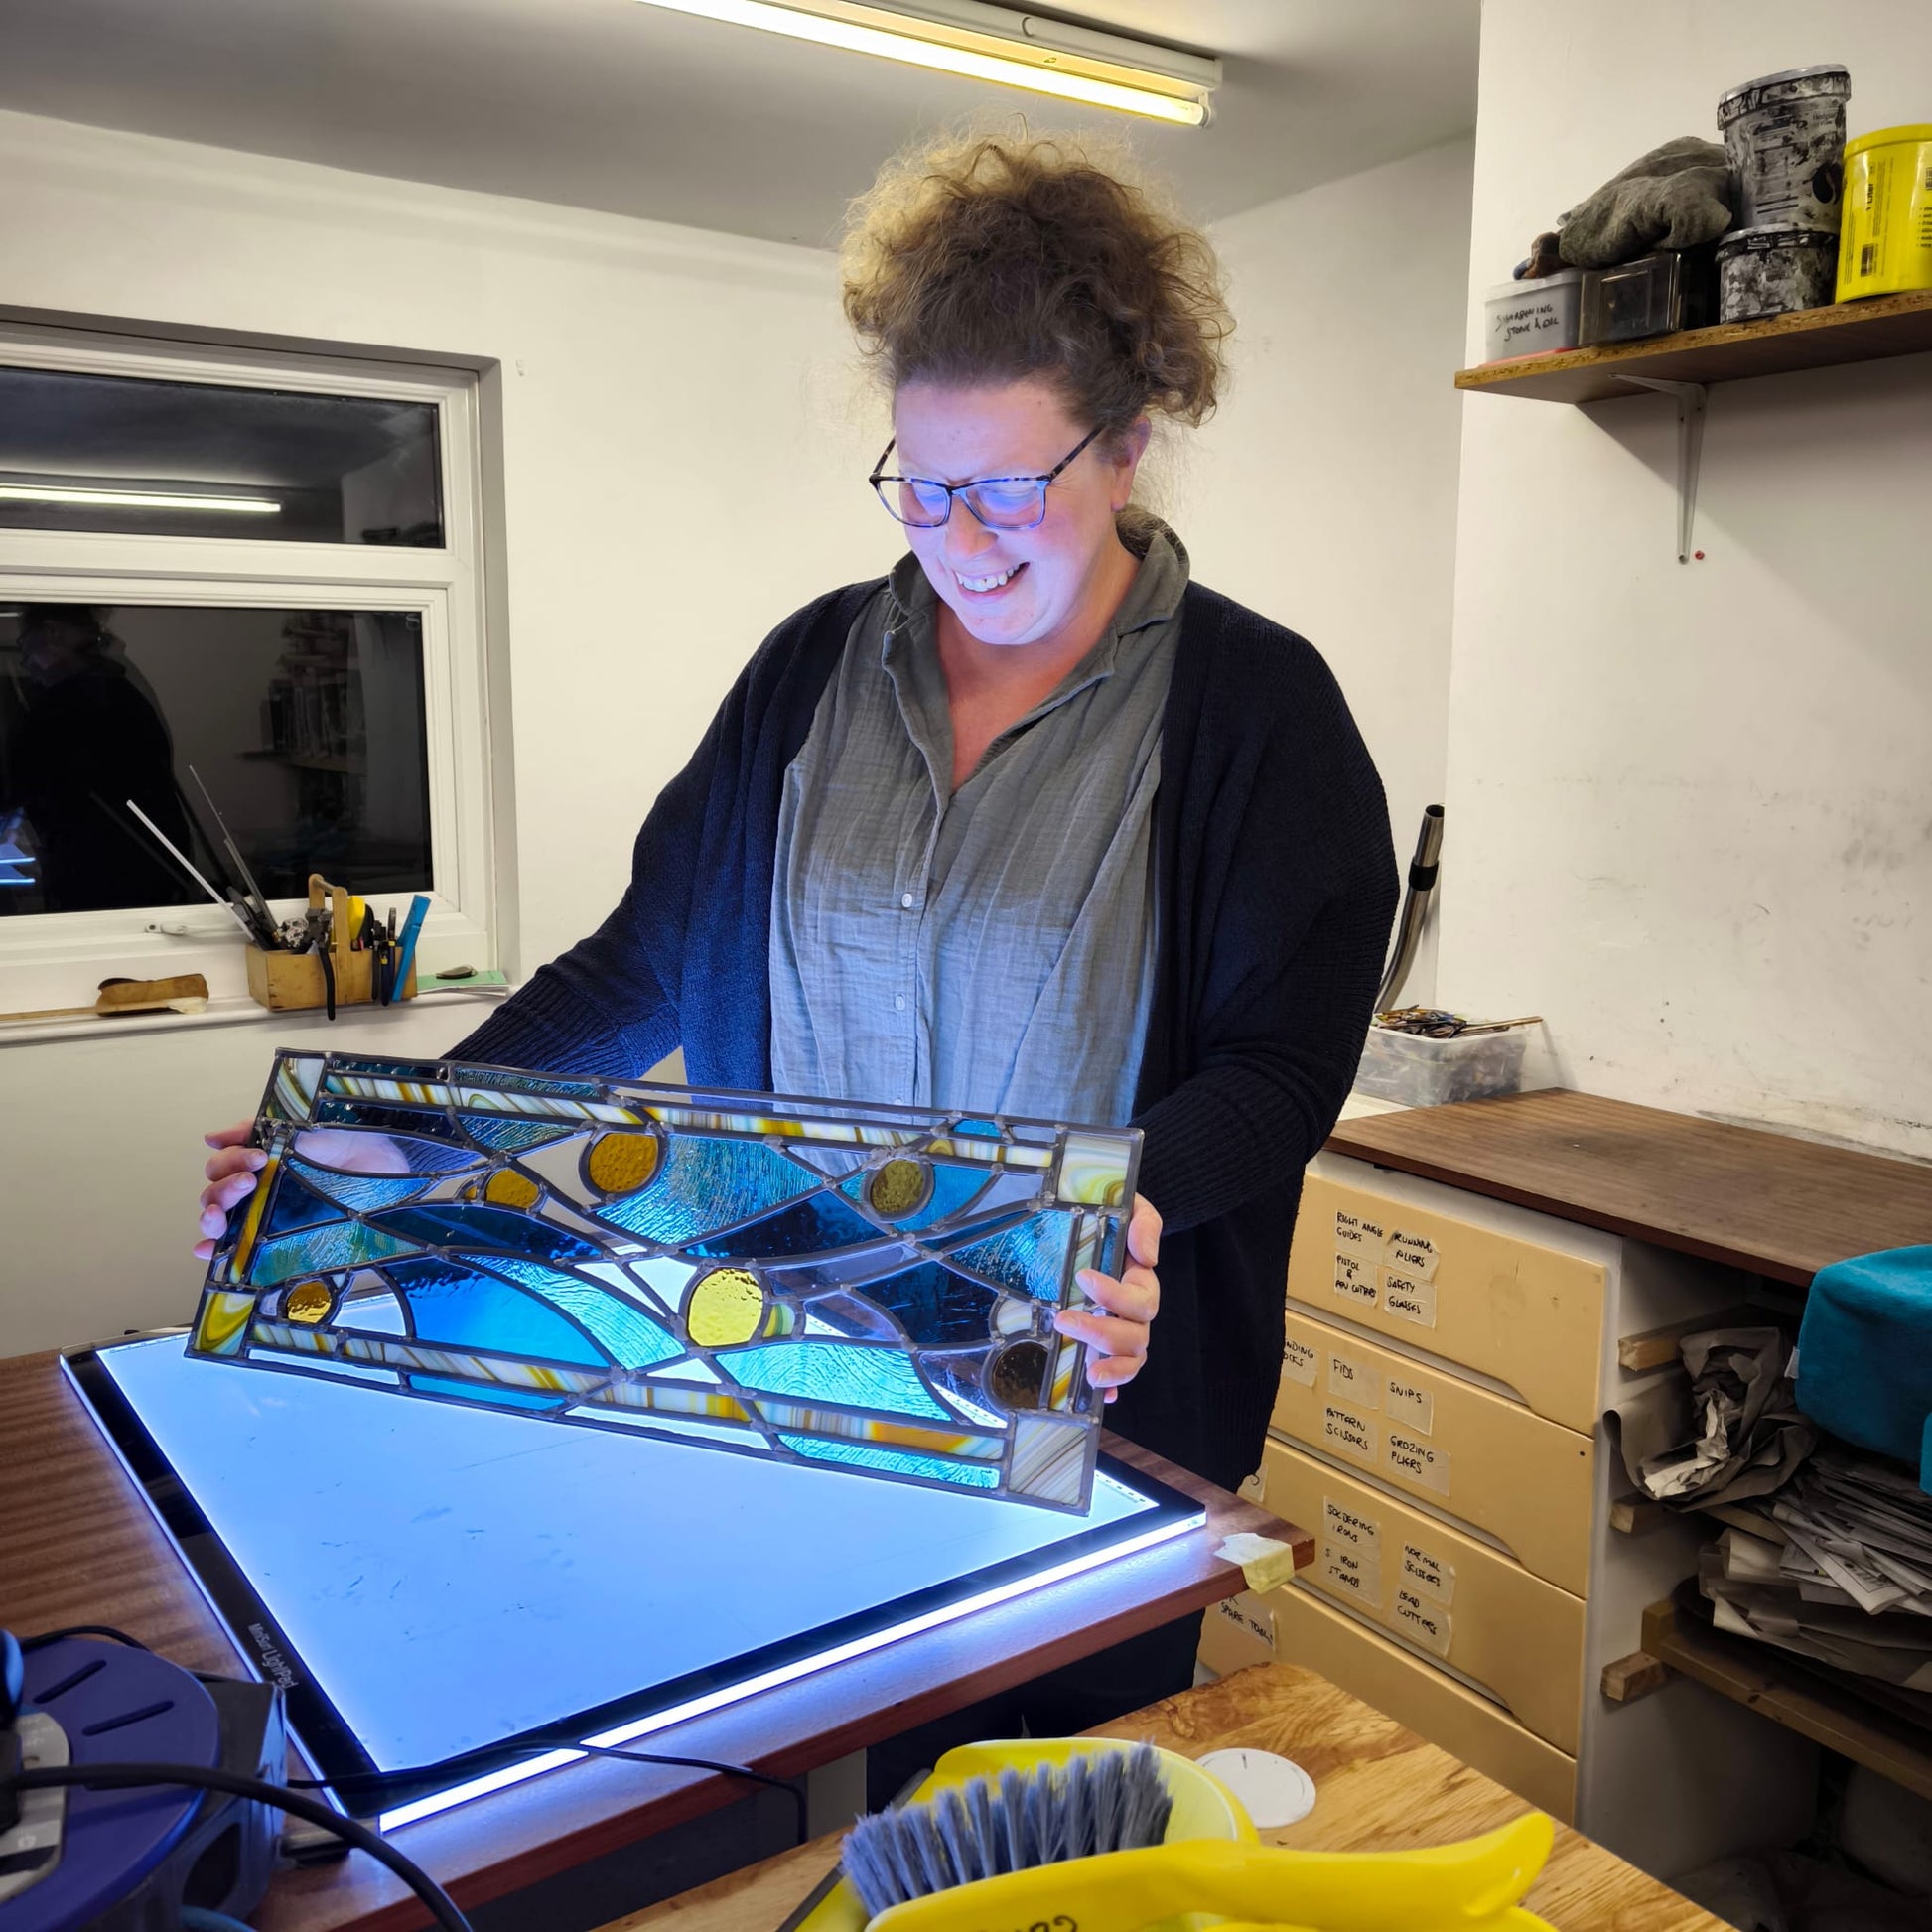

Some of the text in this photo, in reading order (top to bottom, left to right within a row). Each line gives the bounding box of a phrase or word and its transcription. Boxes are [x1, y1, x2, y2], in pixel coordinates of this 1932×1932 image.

[1504, 324, 1531, 342] STONE
[1542, 317, 1559, 328] OIL
[1336, 1211, 1383, 1237] RIGHT ANGLE
[1336, 1227, 1363, 1243] GUIDES
[1393, 1232, 1433, 1253] RUNNING
[1336, 1254, 1360, 1271] PISTOL
[1395, 1250, 1426, 1268] PLIERS
[1351, 1284, 1377, 1299] CUTTERS
[1386, 1276, 1416, 1294] SAFETY
[1388, 1295, 1421, 1315] GLASSES
[1286, 1341, 1314, 1359] NDING
[1389, 1382, 1423, 1404] SNIPS
[1326, 1407, 1366, 1432] PATTERN
[1325, 1423, 1369, 1450] SCISSORS
[1390, 1435, 1435, 1463] GROZING
[1391, 1451, 1422, 1474] PLIERS
[1327, 1504, 1374, 1536] SOLDERING
[1332, 1525, 1358, 1543] IRONS
[1340, 1554, 1358, 1570] IRON
[1328, 1566, 1360, 1588] STANDS
[1404, 1560, 1441, 1587] SCISSORS
[1398, 1589, 1420, 1608] LEAD
[1220, 1601, 1244, 1625] SPARE
[1397, 1605, 1438, 1636] CUTTERS
